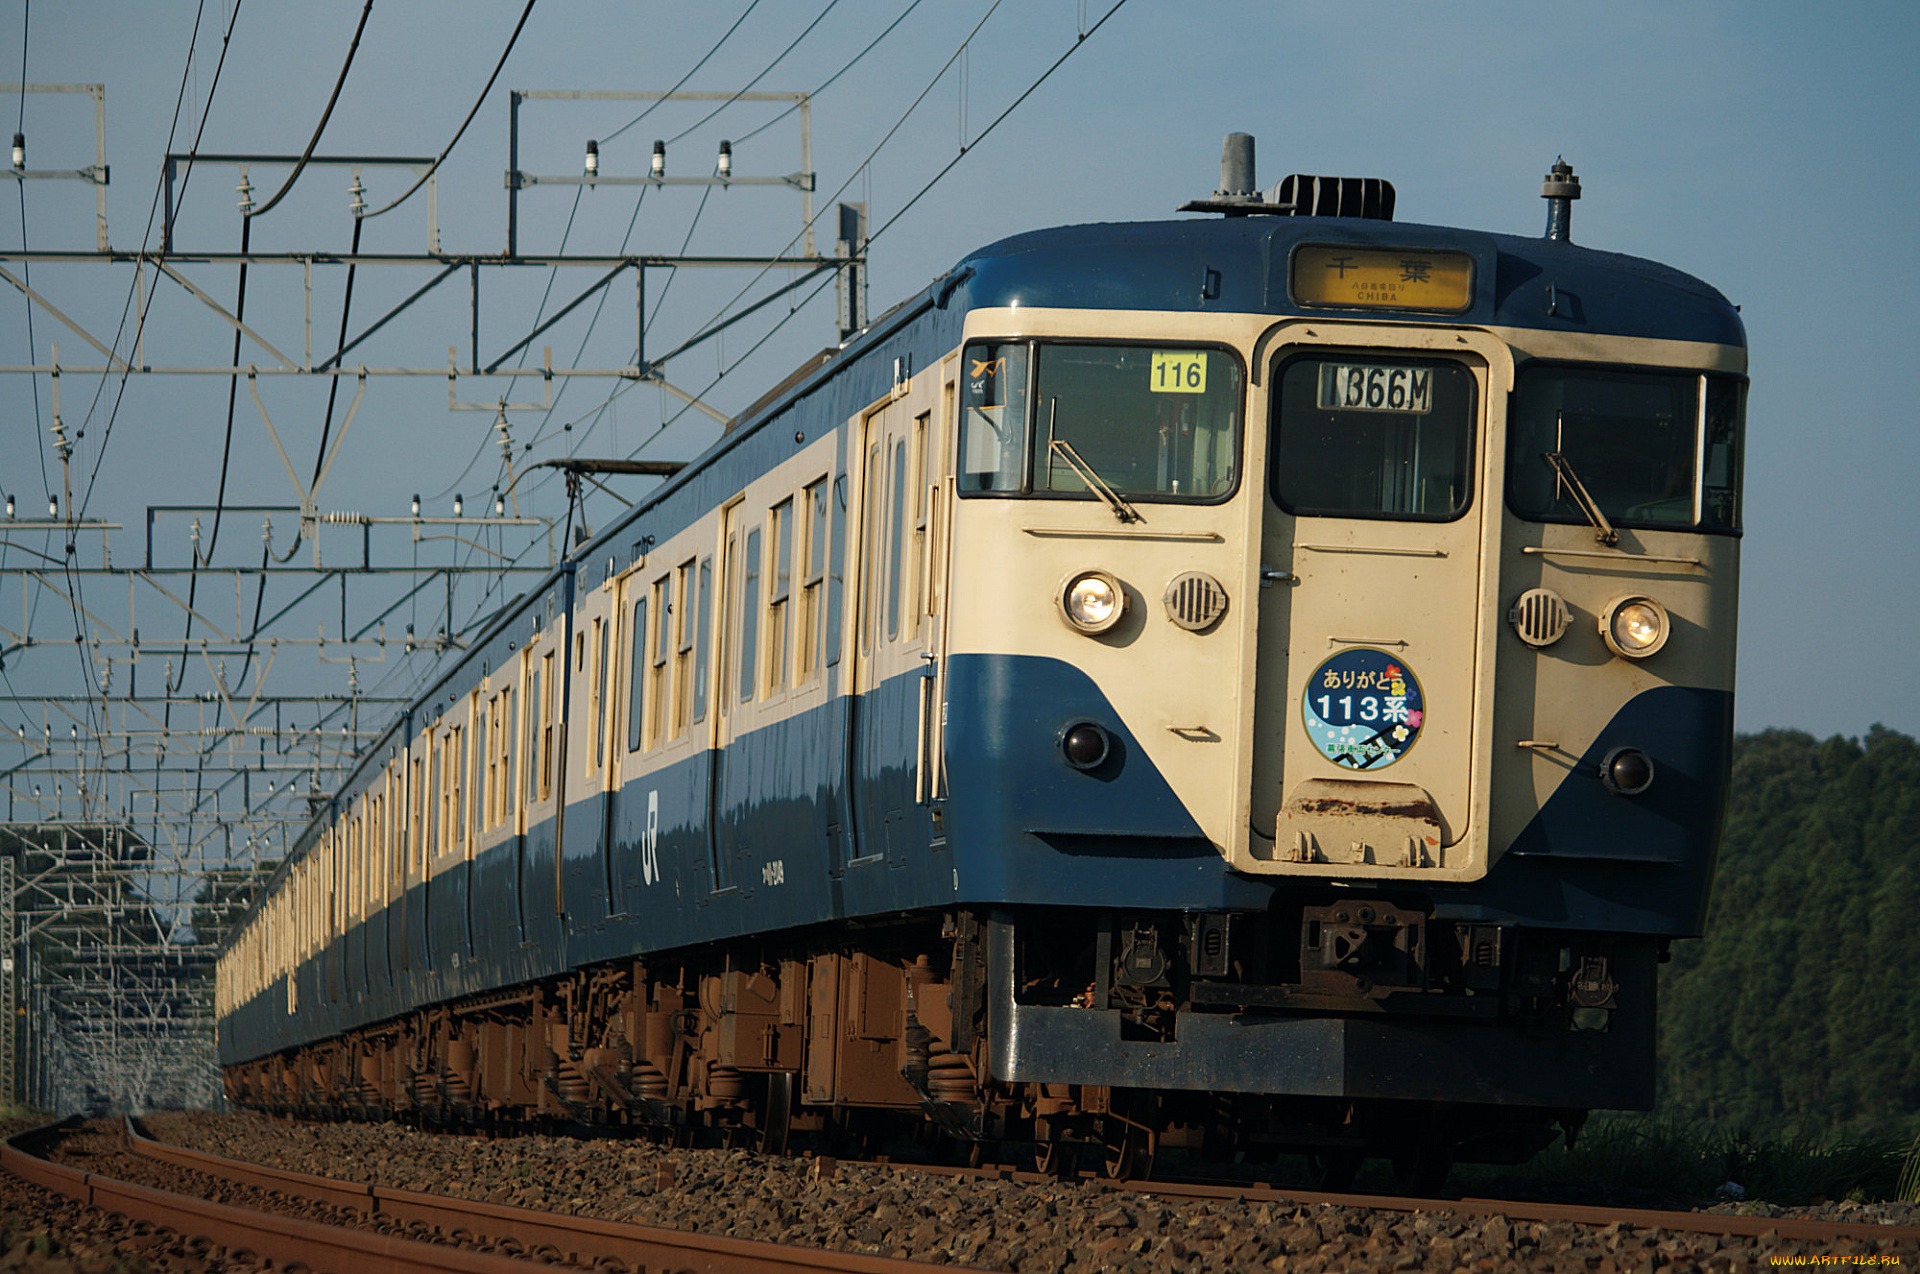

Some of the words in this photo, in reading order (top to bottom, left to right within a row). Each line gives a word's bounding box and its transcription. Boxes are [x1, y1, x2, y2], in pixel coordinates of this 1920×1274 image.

[1357, 291, 1397, 301] CHIBA
[1156, 362, 1202, 388] 116
[1323, 668, 1404, 692] ありがとう
[1317, 694, 1409, 723] 113系
[641, 789, 660, 886] JR
